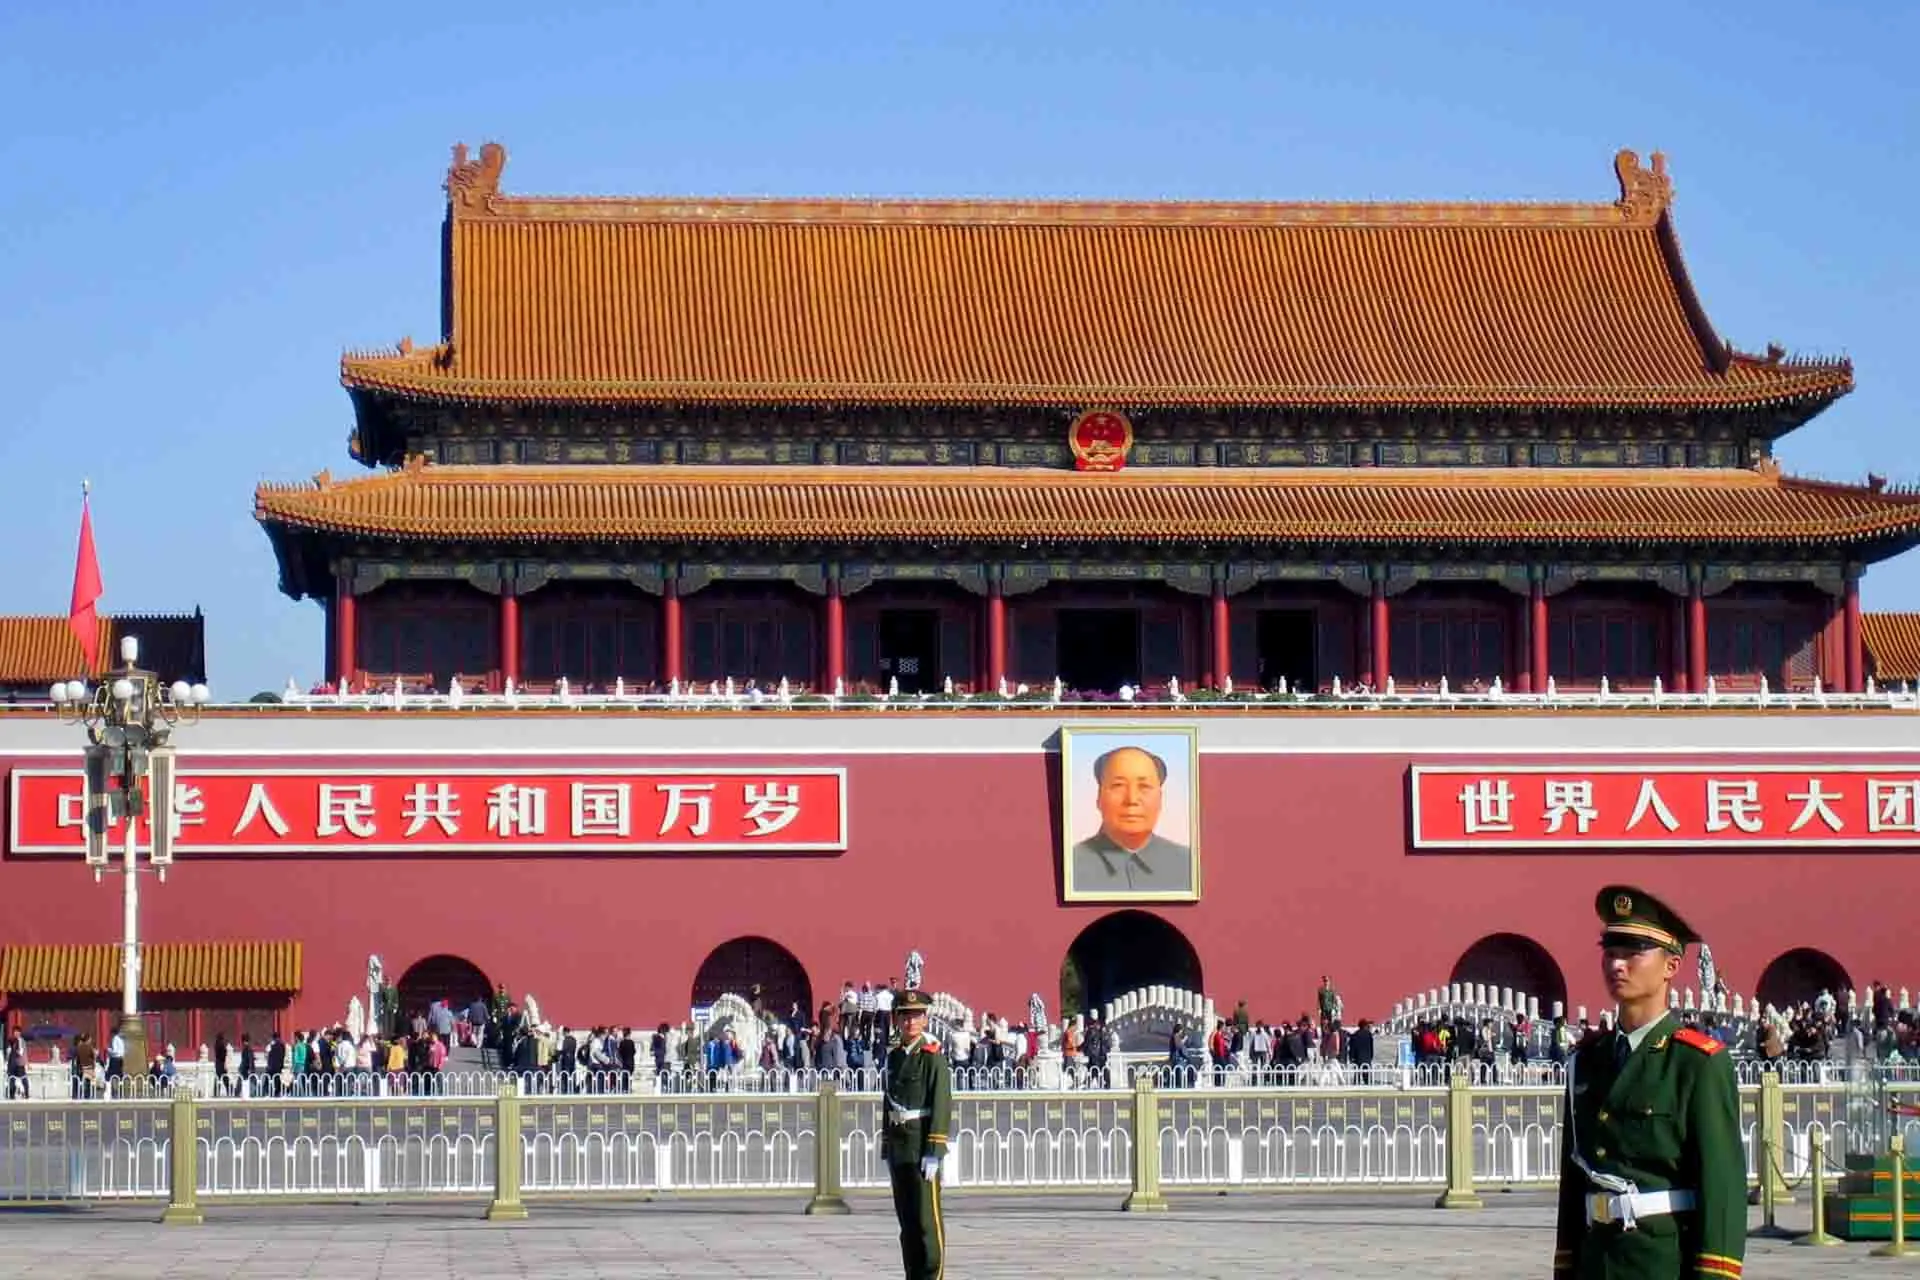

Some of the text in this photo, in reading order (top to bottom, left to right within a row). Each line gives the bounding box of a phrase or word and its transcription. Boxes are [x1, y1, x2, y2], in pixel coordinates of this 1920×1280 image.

[1458, 778, 1920, 833] 世界人民大团
